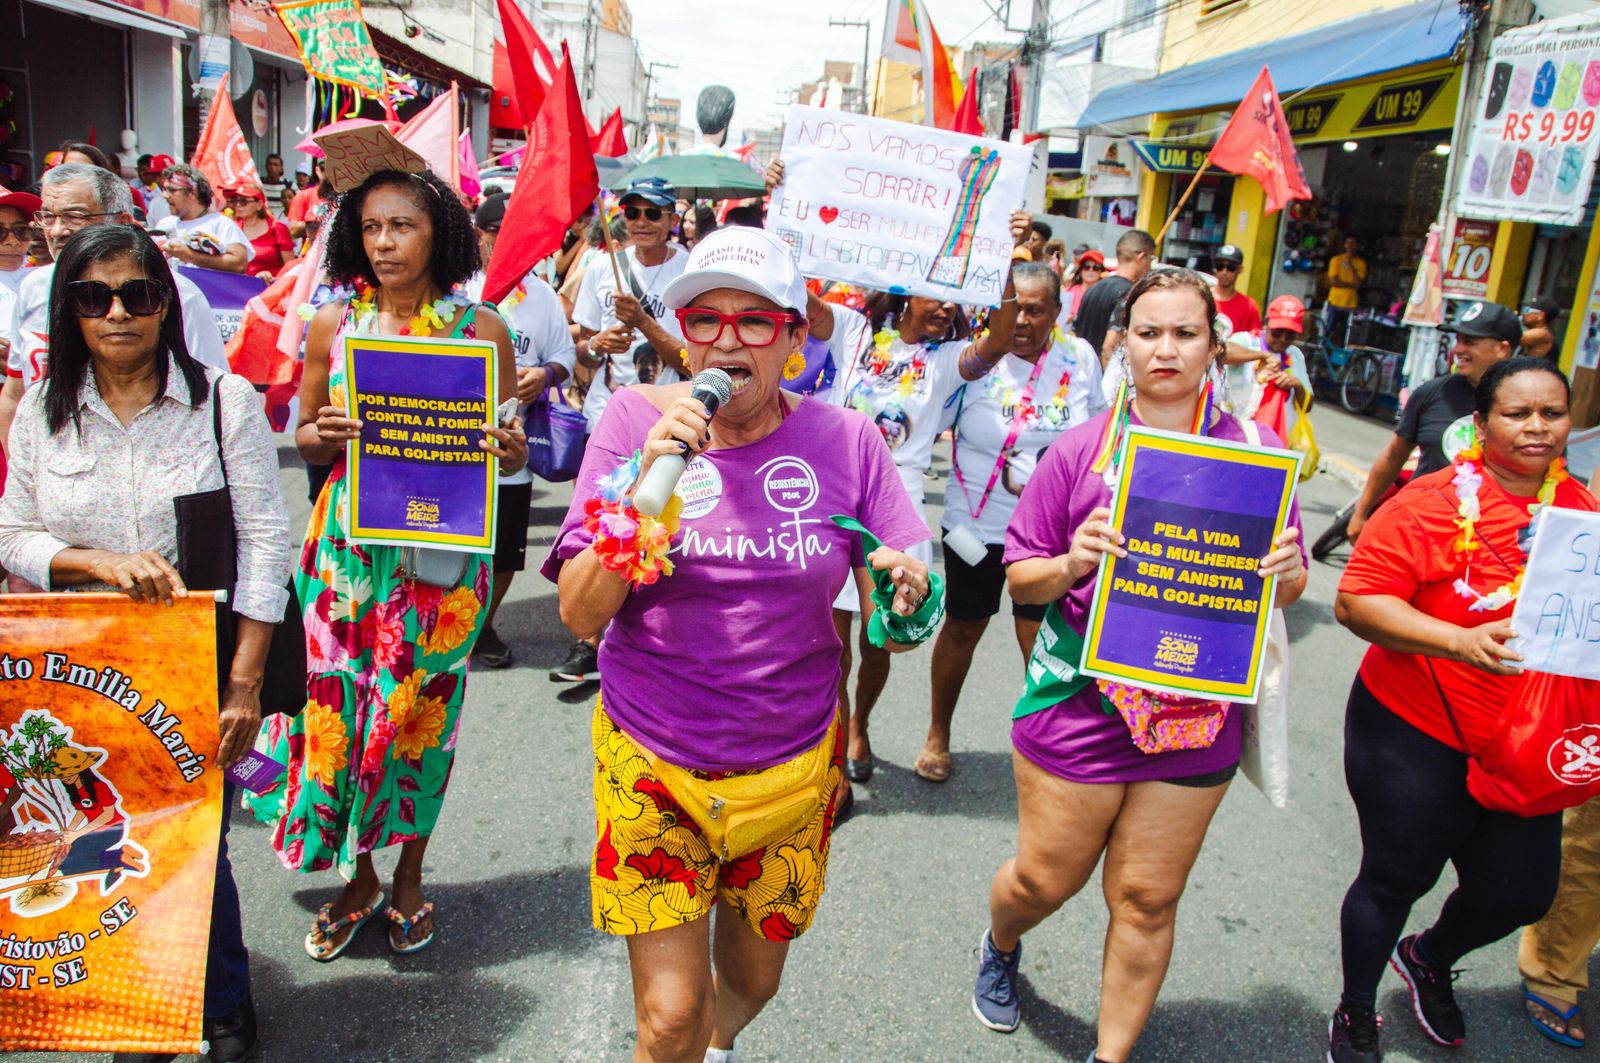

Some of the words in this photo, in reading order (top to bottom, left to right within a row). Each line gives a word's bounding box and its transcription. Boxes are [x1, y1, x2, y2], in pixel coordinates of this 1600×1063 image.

[1306, 105, 1322, 128] 99
[1375, 93, 1400, 121] UM
[1402, 89, 1423, 117] 99
[1503, 112, 1534, 143] R$
[1538, 110, 1595, 147] 9,99
[321, 130, 399, 160] SEM
[868, 130, 956, 172] VAMOS
[1158, 148, 1187, 167] UM
[838, 208, 871, 232] SER
[1451, 244, 1491, 280] 10
[357, 393, 386, 406] POR
[389, 396, 486, 412] DEMOCRACIA!
[365, 411, 422, 426] CONTRA
[425, 416, 435, 427] A
[438, 417, 483, 430] FOME!
[380, 428, 408, 441] SEM
[412, 432, 468, 446] ANISTIA
[365, 443, 400, 456] PARA
[403, 448, 485, 462] GOLPISTAS!
[685, 461, 705, 472] EITE
[768, 477, 811, 490] RESISTÊNCIA
[782, 491, 801, 500] PSOL
[406, 511, 440, 523] MEIRE
[667, 512, 832, 570] minista
[1153, 522, 1198, 542] PELA
[1203, 531, 1241, 548] VIDA
[1128, 538, 1163, 557] DAS
[1166, 545, 1260, 572] MULHERES!
[1136, 562, 1175, 580] SEM
[1177, 570, 1244, 591] ANISTIA
[1113, 577, 1159, 598] PARA
[1163, 588, 1259, 613] GOLPISTAS!
[1154, 649, 1198, 666] MEIRE
[42, 652, 142, 712] Emilia
[138, 700, 206, 782] Maria
[0, 929, 86, 960] ristovão
[99, 897, 138, 935] SE
[0, 964, 35, 990] ST
[53, 958, 88, 988] SE
